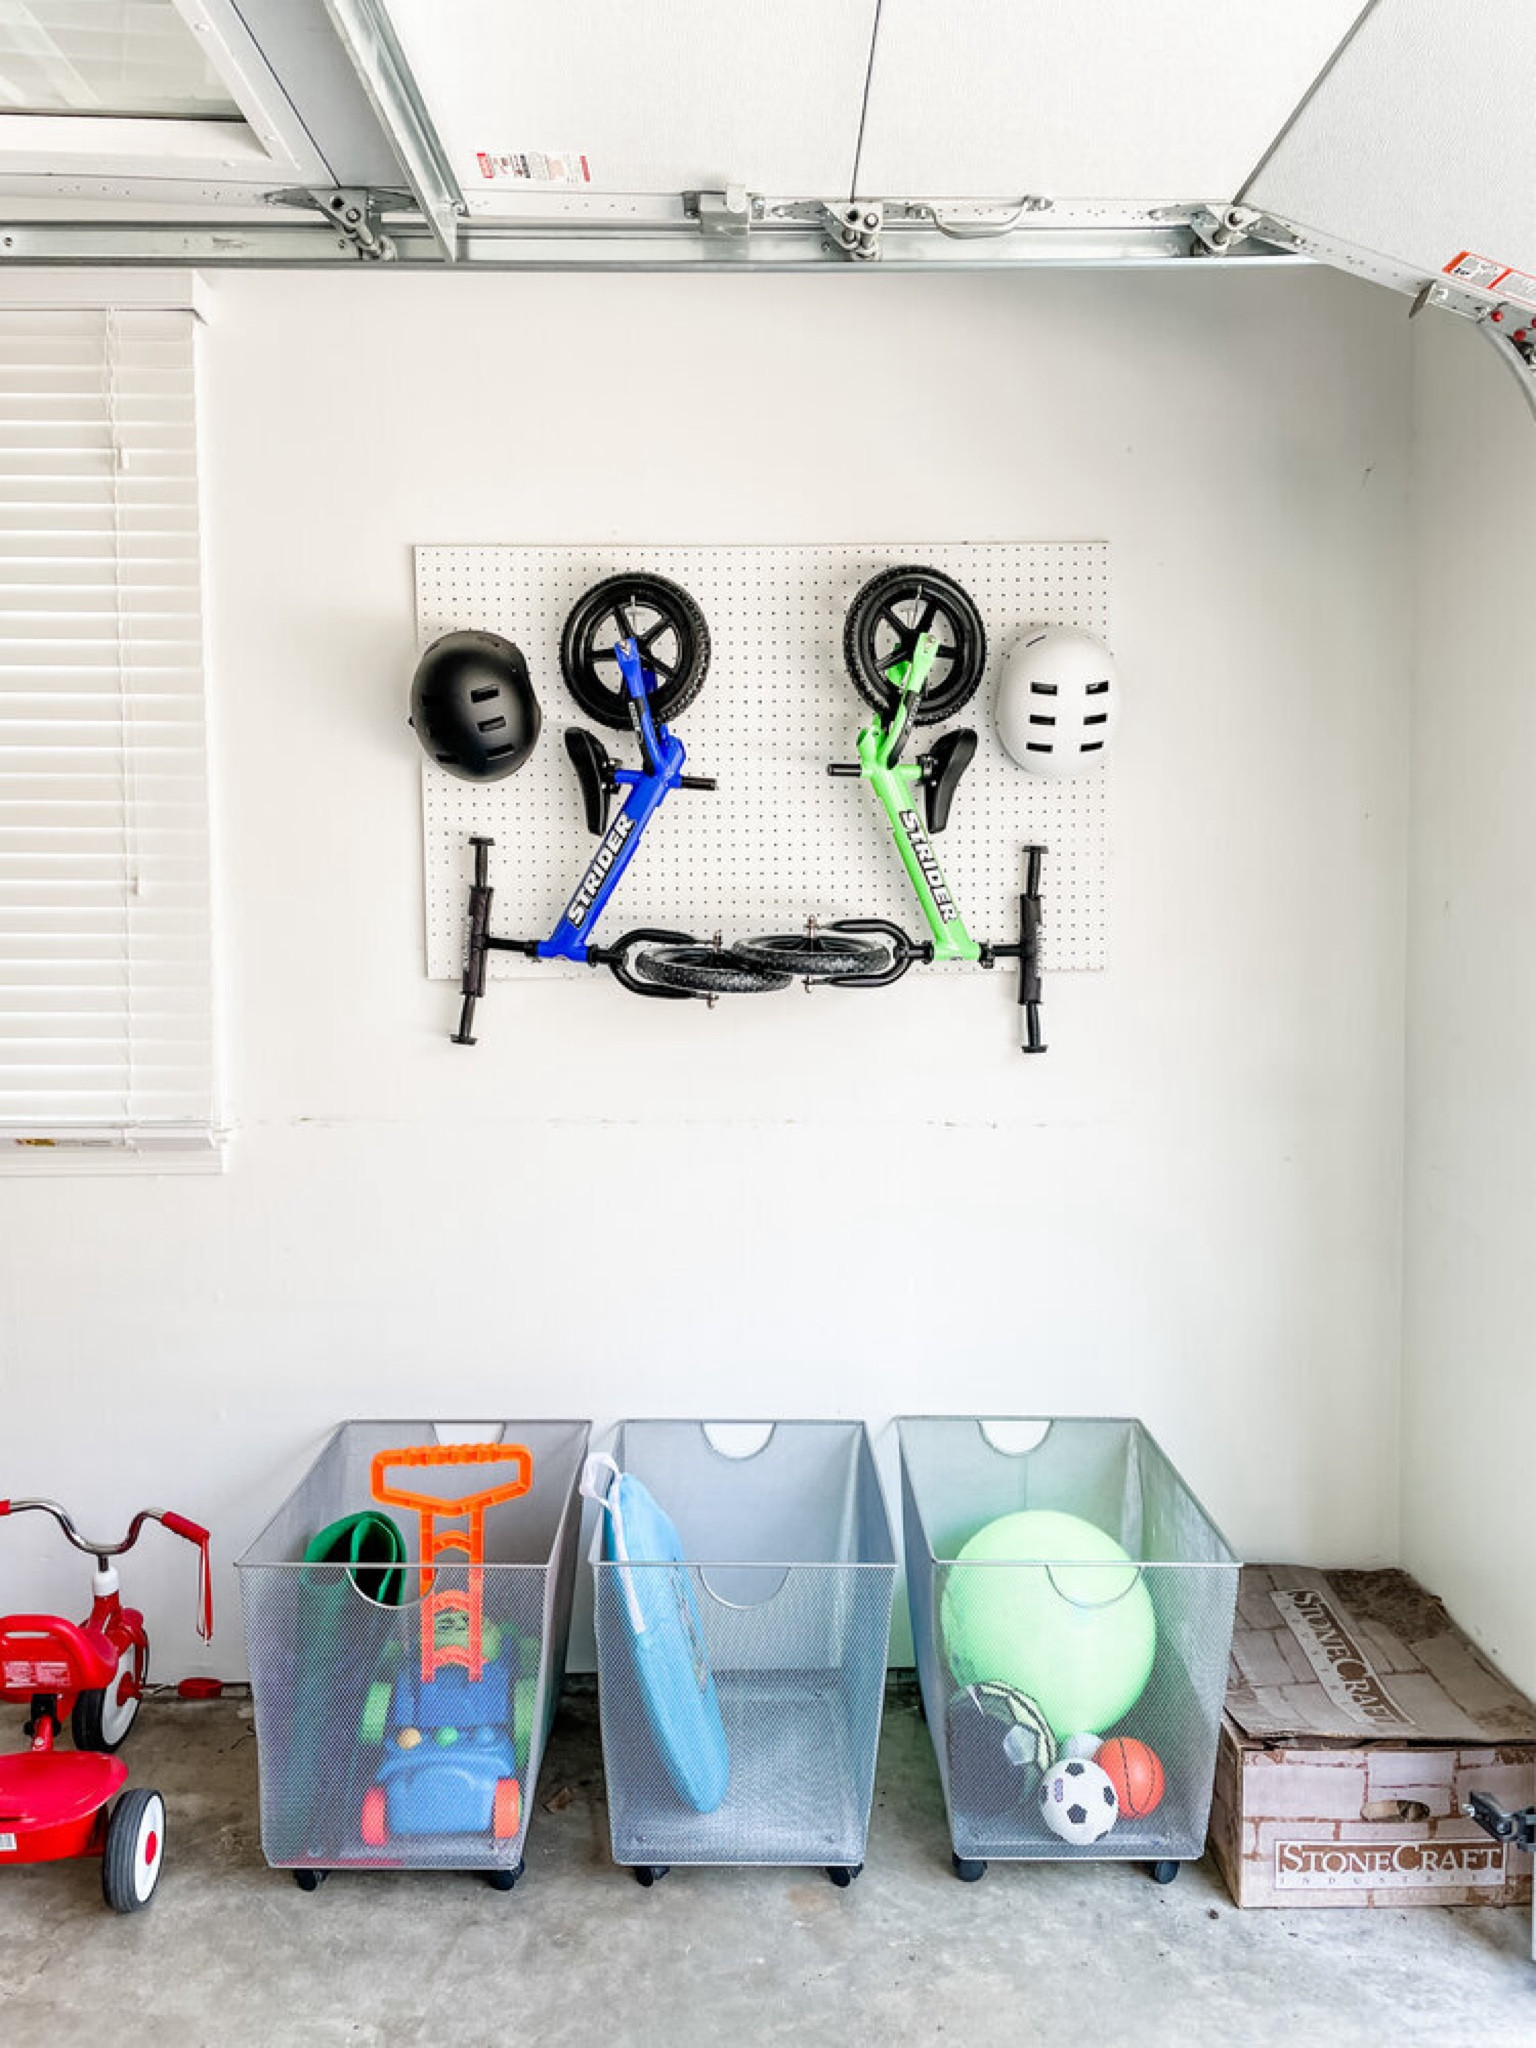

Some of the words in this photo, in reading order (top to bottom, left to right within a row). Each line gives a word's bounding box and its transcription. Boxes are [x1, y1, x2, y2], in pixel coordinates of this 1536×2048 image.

[566, 812, 635, 928] STRIDER
[898, 809, 957, 924] STRIDER
[1282, 1844, 1501, 1874] STONECRAFT
